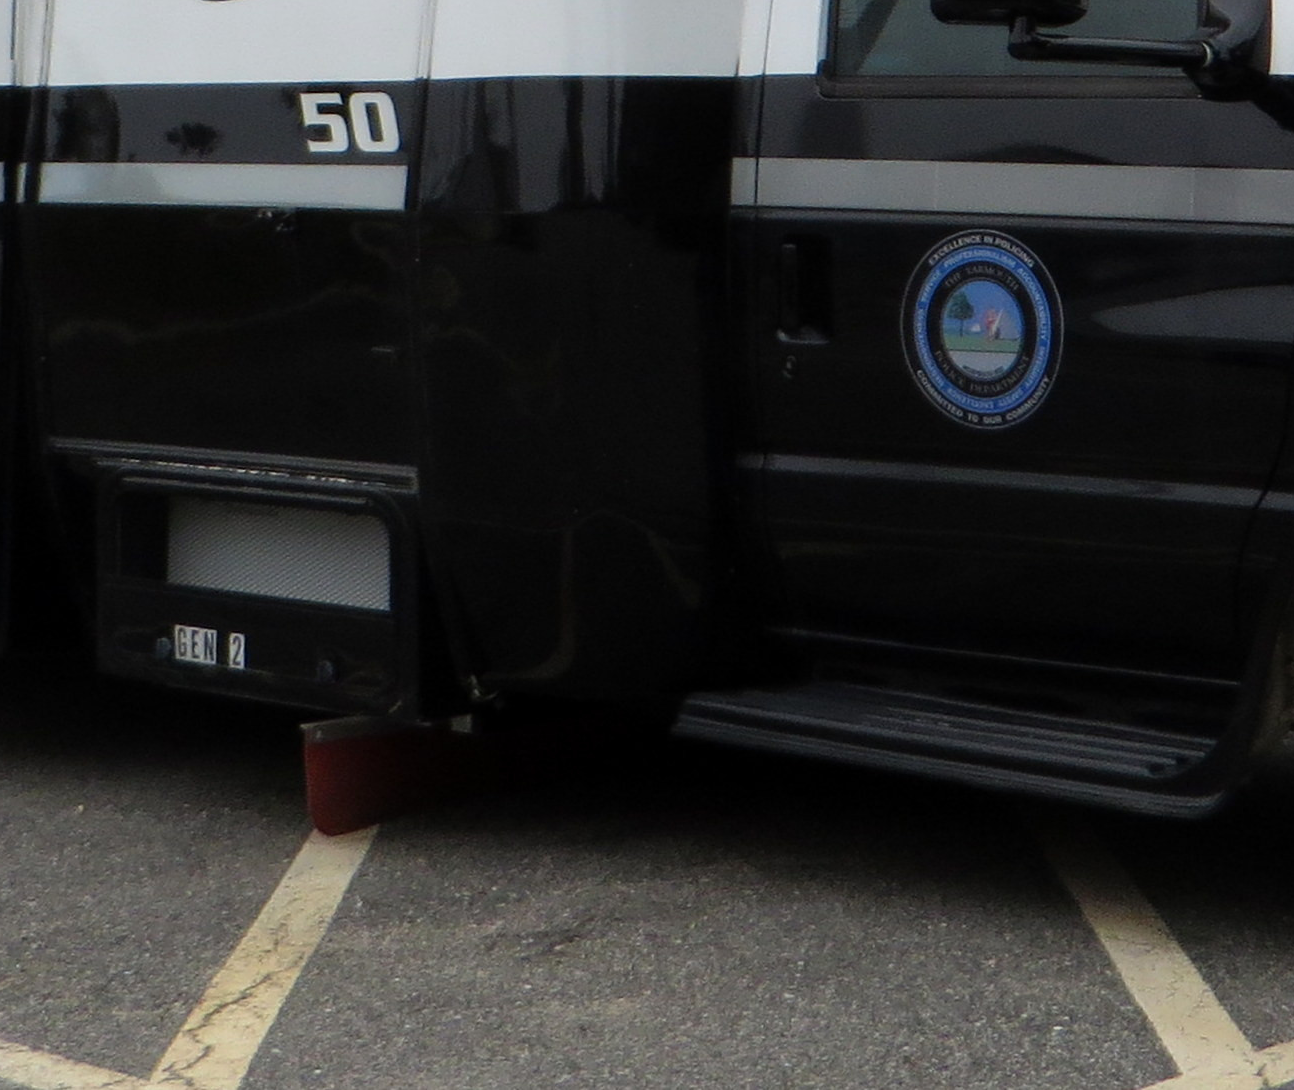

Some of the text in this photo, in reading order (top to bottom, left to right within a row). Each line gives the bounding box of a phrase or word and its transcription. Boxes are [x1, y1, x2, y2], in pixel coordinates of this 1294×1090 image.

[300, 91, 401, 152] 50
[928, 234, 1035, 268] EXCELLENCE IN POLICING
[916, 368, 964, 419] COMMITTED
[967, 413, 979, 424] TO
[982, 414, 1003, 425] OUR
[1005, 376, 1051, 421] COMMUNITY
[176, 626, 245, 668] GEN 2
